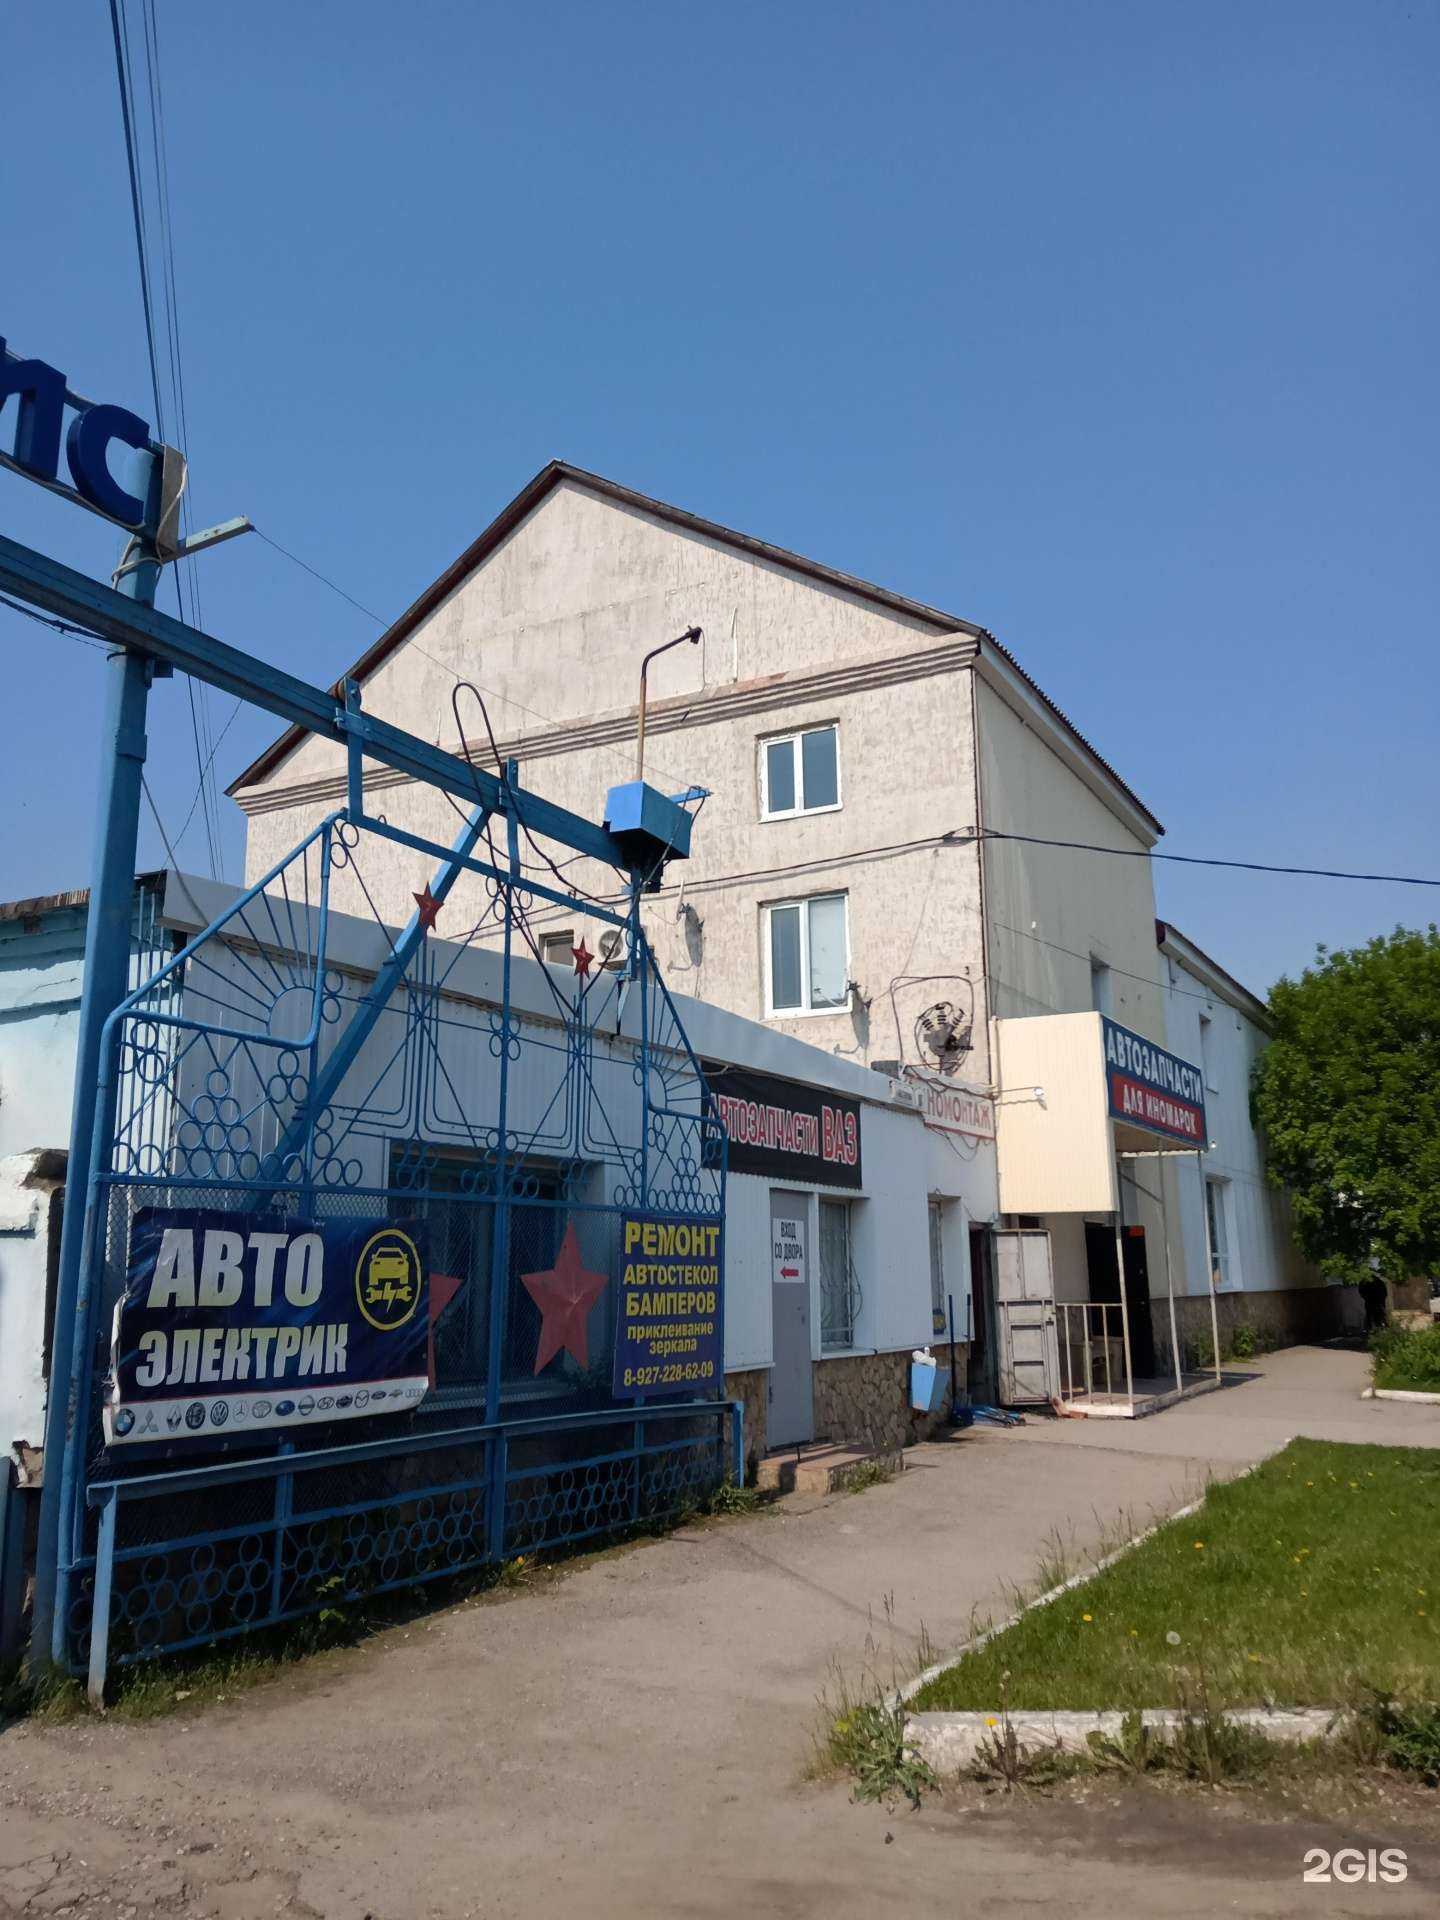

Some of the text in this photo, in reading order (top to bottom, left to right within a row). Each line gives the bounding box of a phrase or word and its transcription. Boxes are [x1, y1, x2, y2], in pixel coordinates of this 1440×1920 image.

[1107, 1027, 1202, 1104] АВТОЗАПЧАСТИ
[916, 1088, 992, 1131] НОМОНТАЖ
[1123, 1084, 1197, 1134] ДЛЯ ИНОМАРОК
[822, 1105, 857, 1166] ВАЗ
[624, 1221, 719, 1257] РЕМОНТ
[781, 1221, 796, 1240] ВХОД
[775, 1242, 782, 1258] СО
[147, 1228, 324, 1308] АВТО
[623, 1264, 718, 1286] АВТОСТЕКОЛ
[626, 1291, 716, 1317] БАМПЕРОВ
[627, 1321, 714, 1344] приклеивание
[649, 1338, 697, 1358] зеркала
[135, 1323, 348, 1388] ЭЛЕКТРИК
[623, 1360, 714, 1386] 8-927-228-62-09
